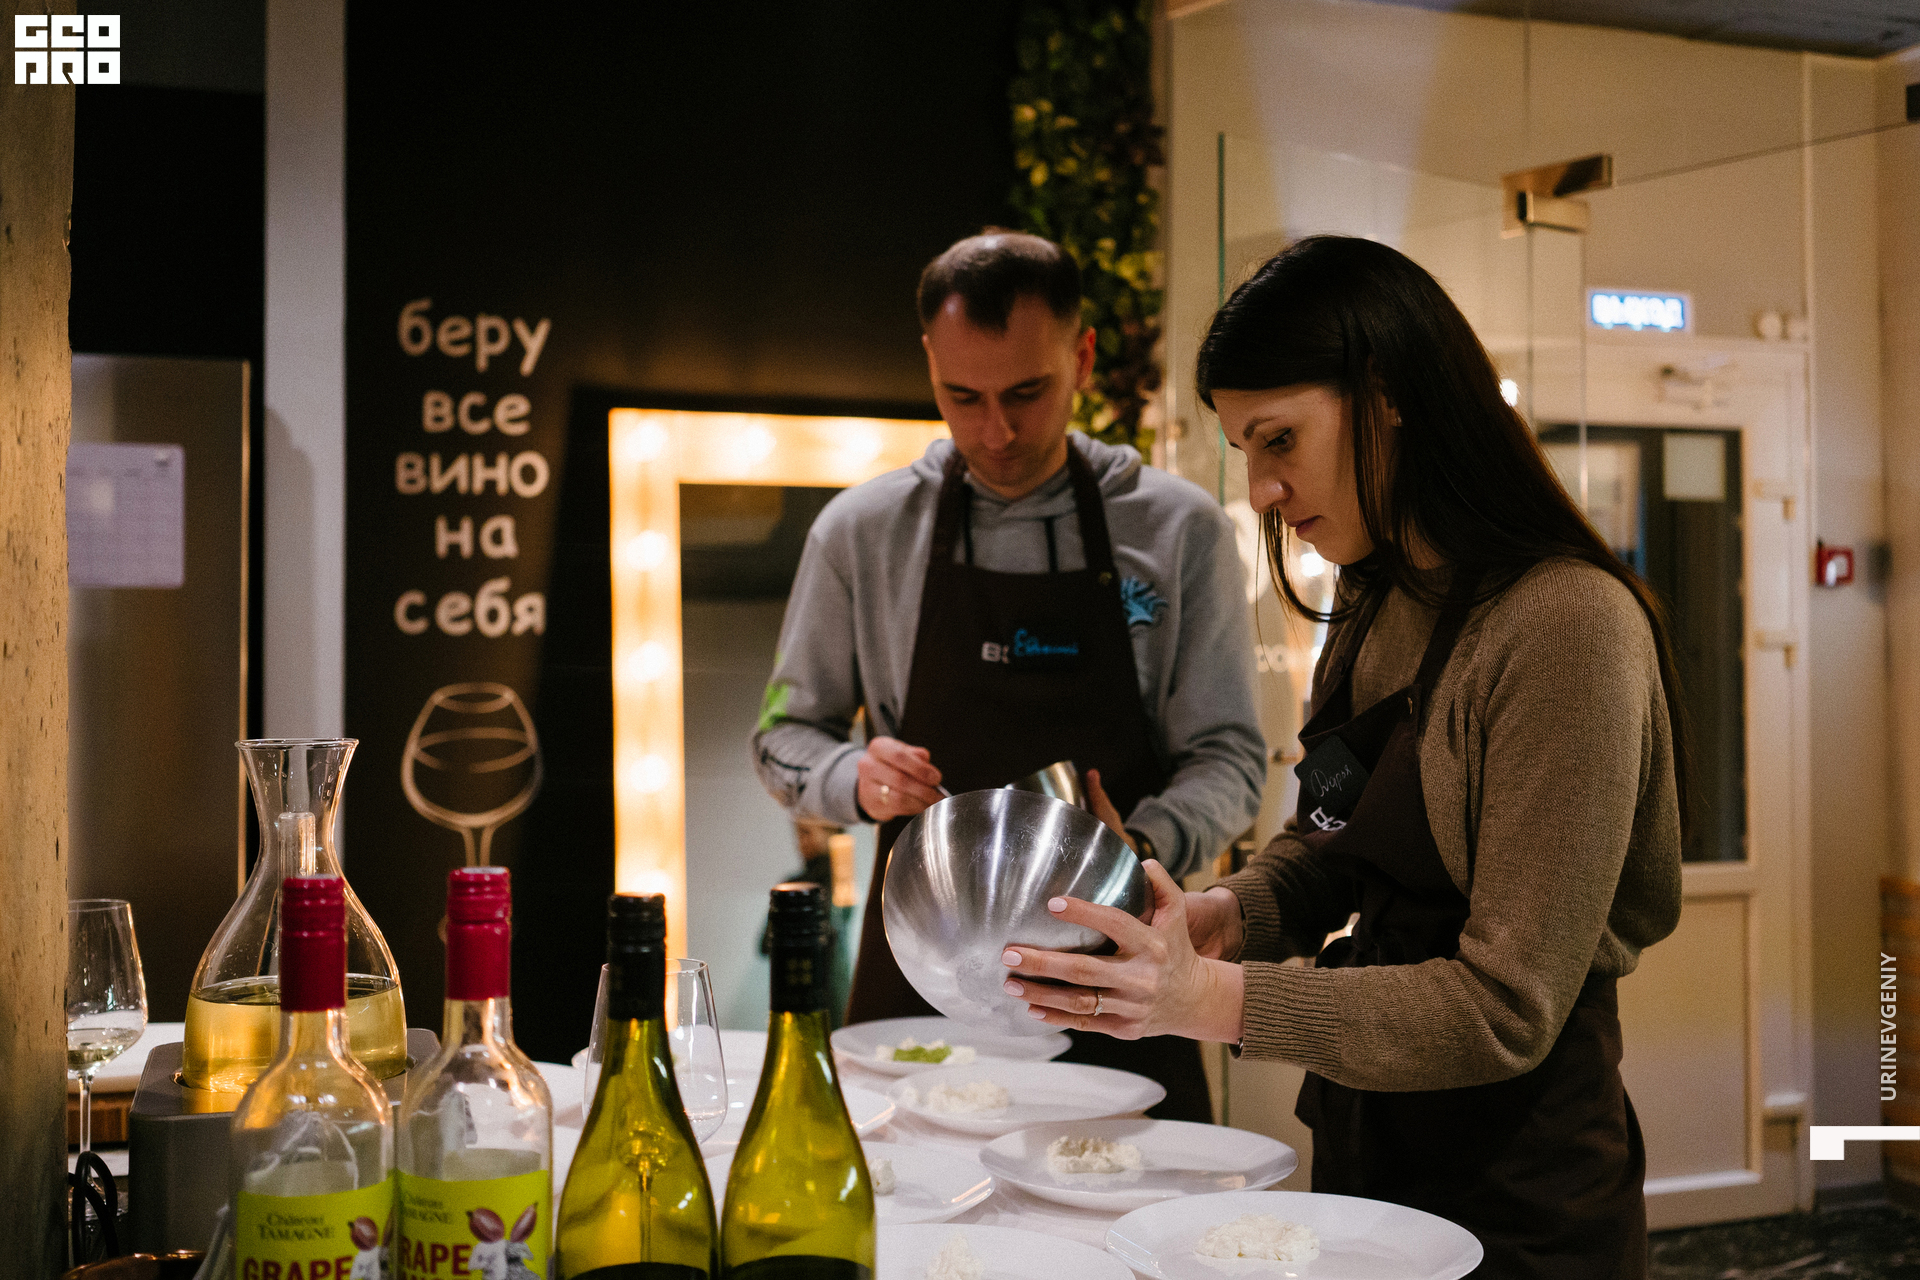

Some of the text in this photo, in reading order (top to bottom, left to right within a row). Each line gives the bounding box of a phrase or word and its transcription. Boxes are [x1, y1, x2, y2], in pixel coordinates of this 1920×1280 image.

[398, 298, 551, 377] беру
[422, 389, 532, 437] все
[395, 451, 550, 498] вино
[435, 514, 519, 559] на
[394, 576, 546, 638] себя
[243, 1256, 352, 1280] GRAPE
